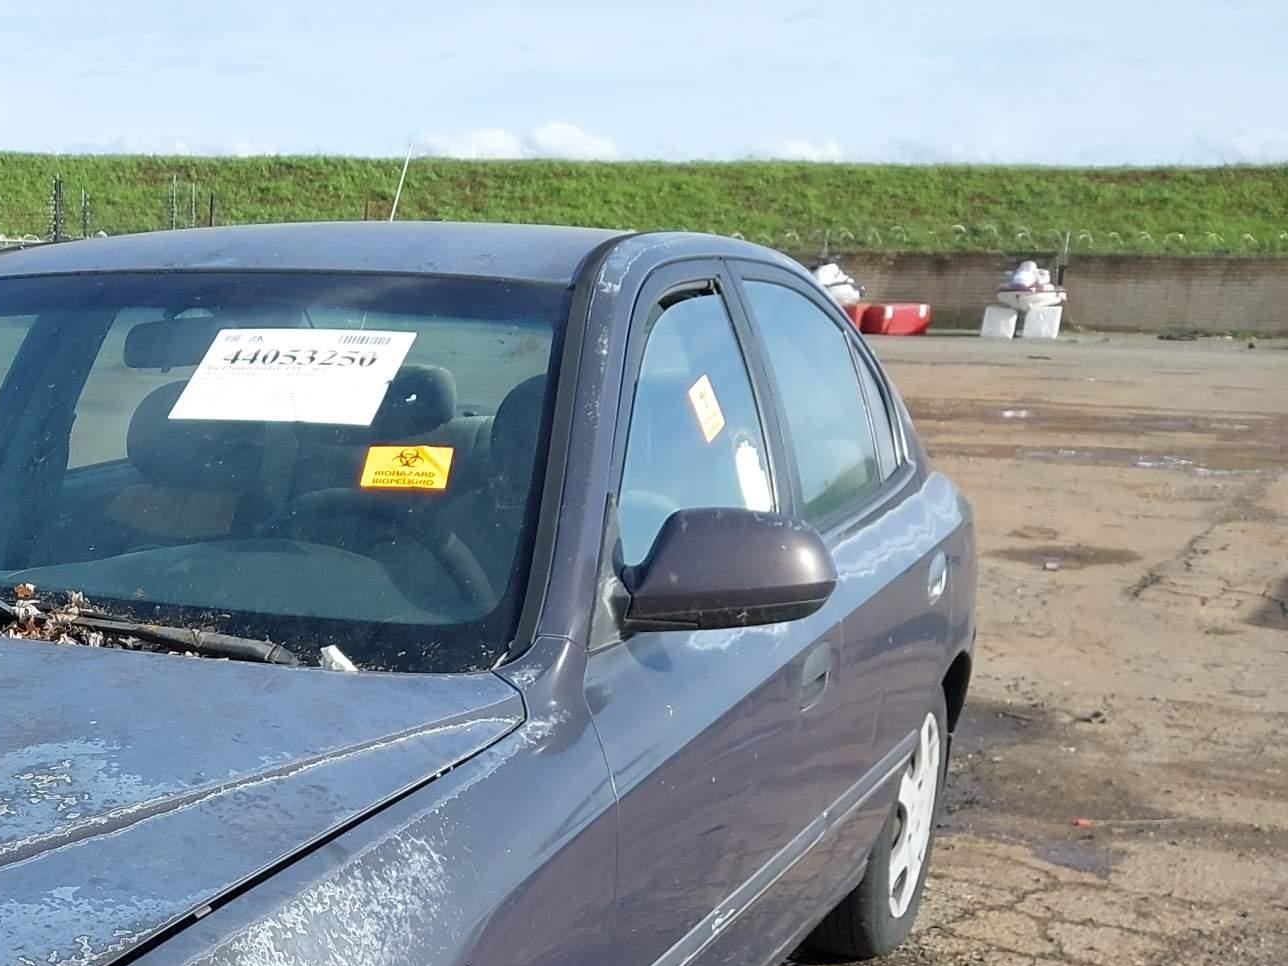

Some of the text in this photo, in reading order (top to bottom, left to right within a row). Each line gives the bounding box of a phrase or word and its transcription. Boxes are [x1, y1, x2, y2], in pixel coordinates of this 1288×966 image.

[223, 349, 377, 367] 44053250
[374, 470, 436, 478] BIOHAZARD
[371, 478, 434, 486] BIOPELIGRO
